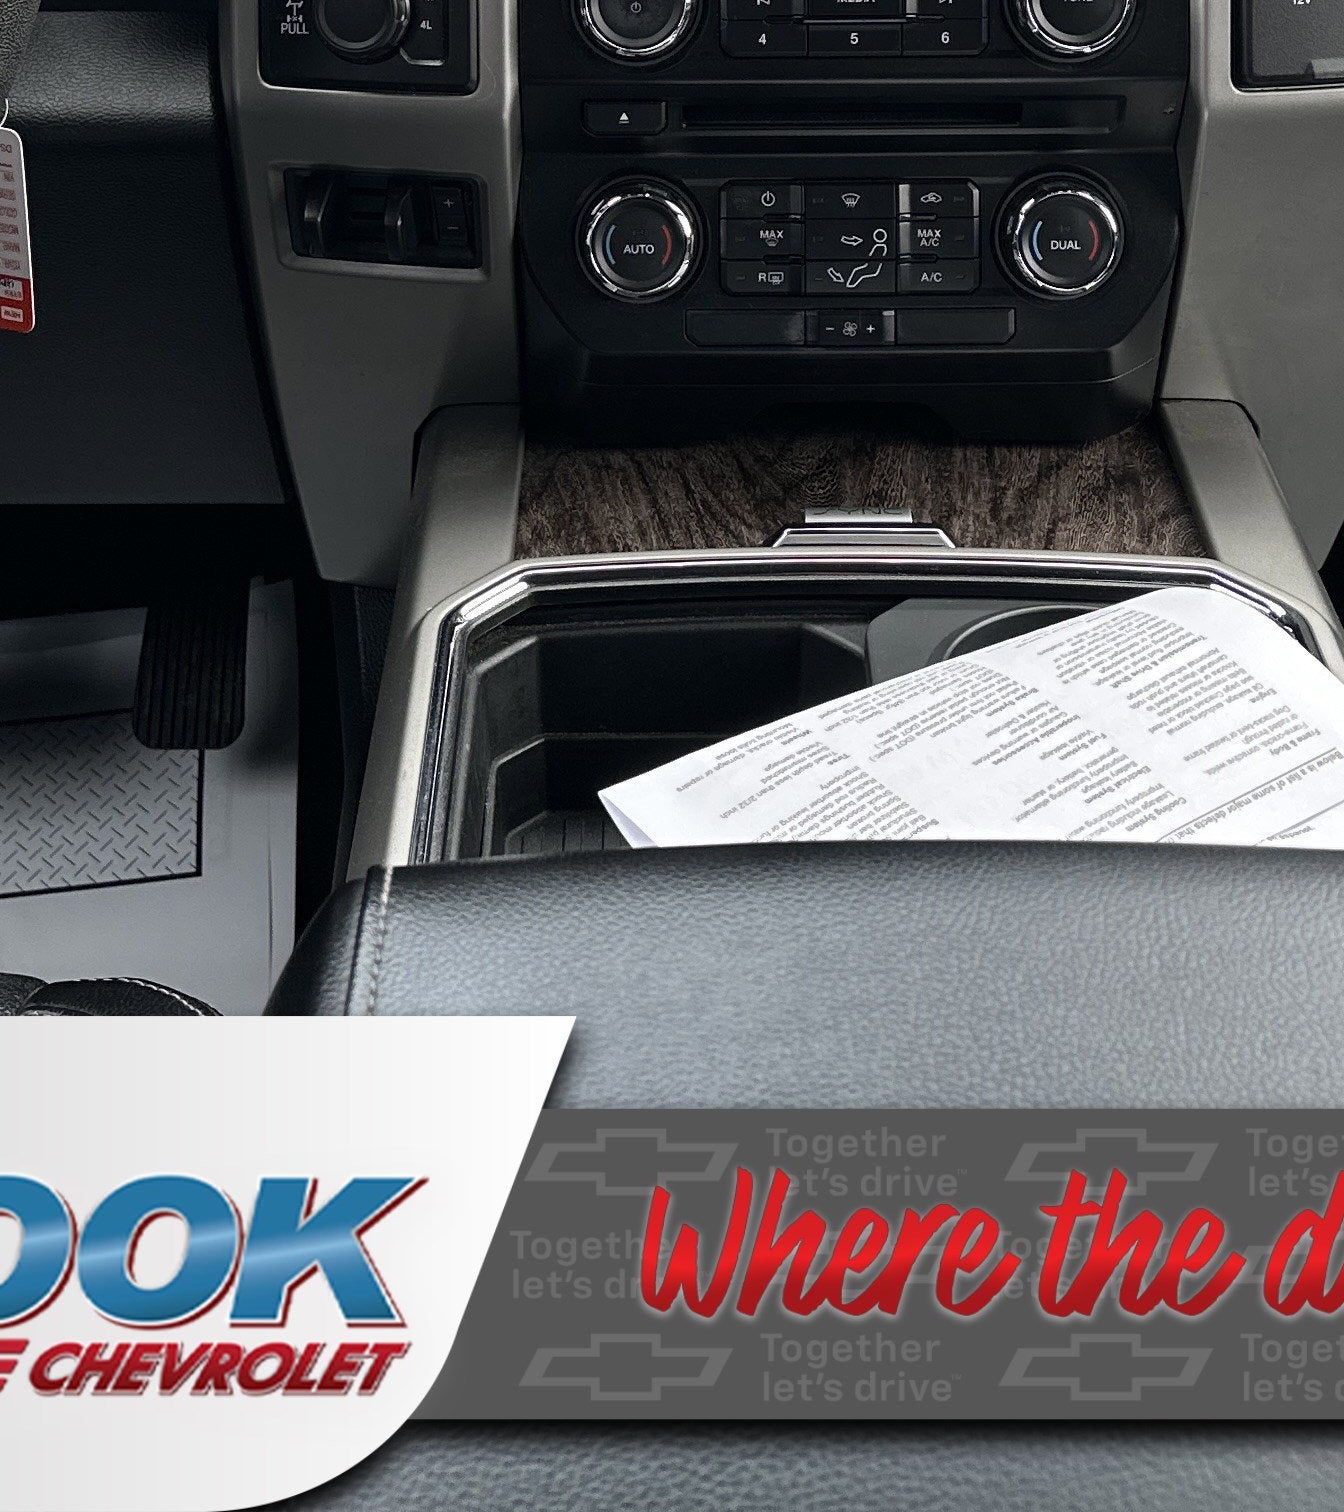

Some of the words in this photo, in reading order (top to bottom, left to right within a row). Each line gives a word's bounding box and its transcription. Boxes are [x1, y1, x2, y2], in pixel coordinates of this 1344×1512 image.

[280, 22, 309, 35] PULL
[419, 19, 433, 30] 4L
[758, 33, 767, 45] 4
[849, 33, 859, 45] 5
[941, 31, 950, 44] 6
[759, 229, 784, 239] MAX
[917, 228, 941, 238] MAX
[919, 237, 940, 247] A/C
[1050, 239, 1081, 251] DUAL
[623, 243, 655, 255] AUTO
[920, 272, 943, 283] A/C
[1316, 750, 1343, 767] Below
[1285, 772, 1302, 784] list
[1251, 784, 1275, 800] some
[1227, 797, 1251, 813] major
[1194, 810, 1225, 829] defects
[1174, 826, 1195, 839] that
